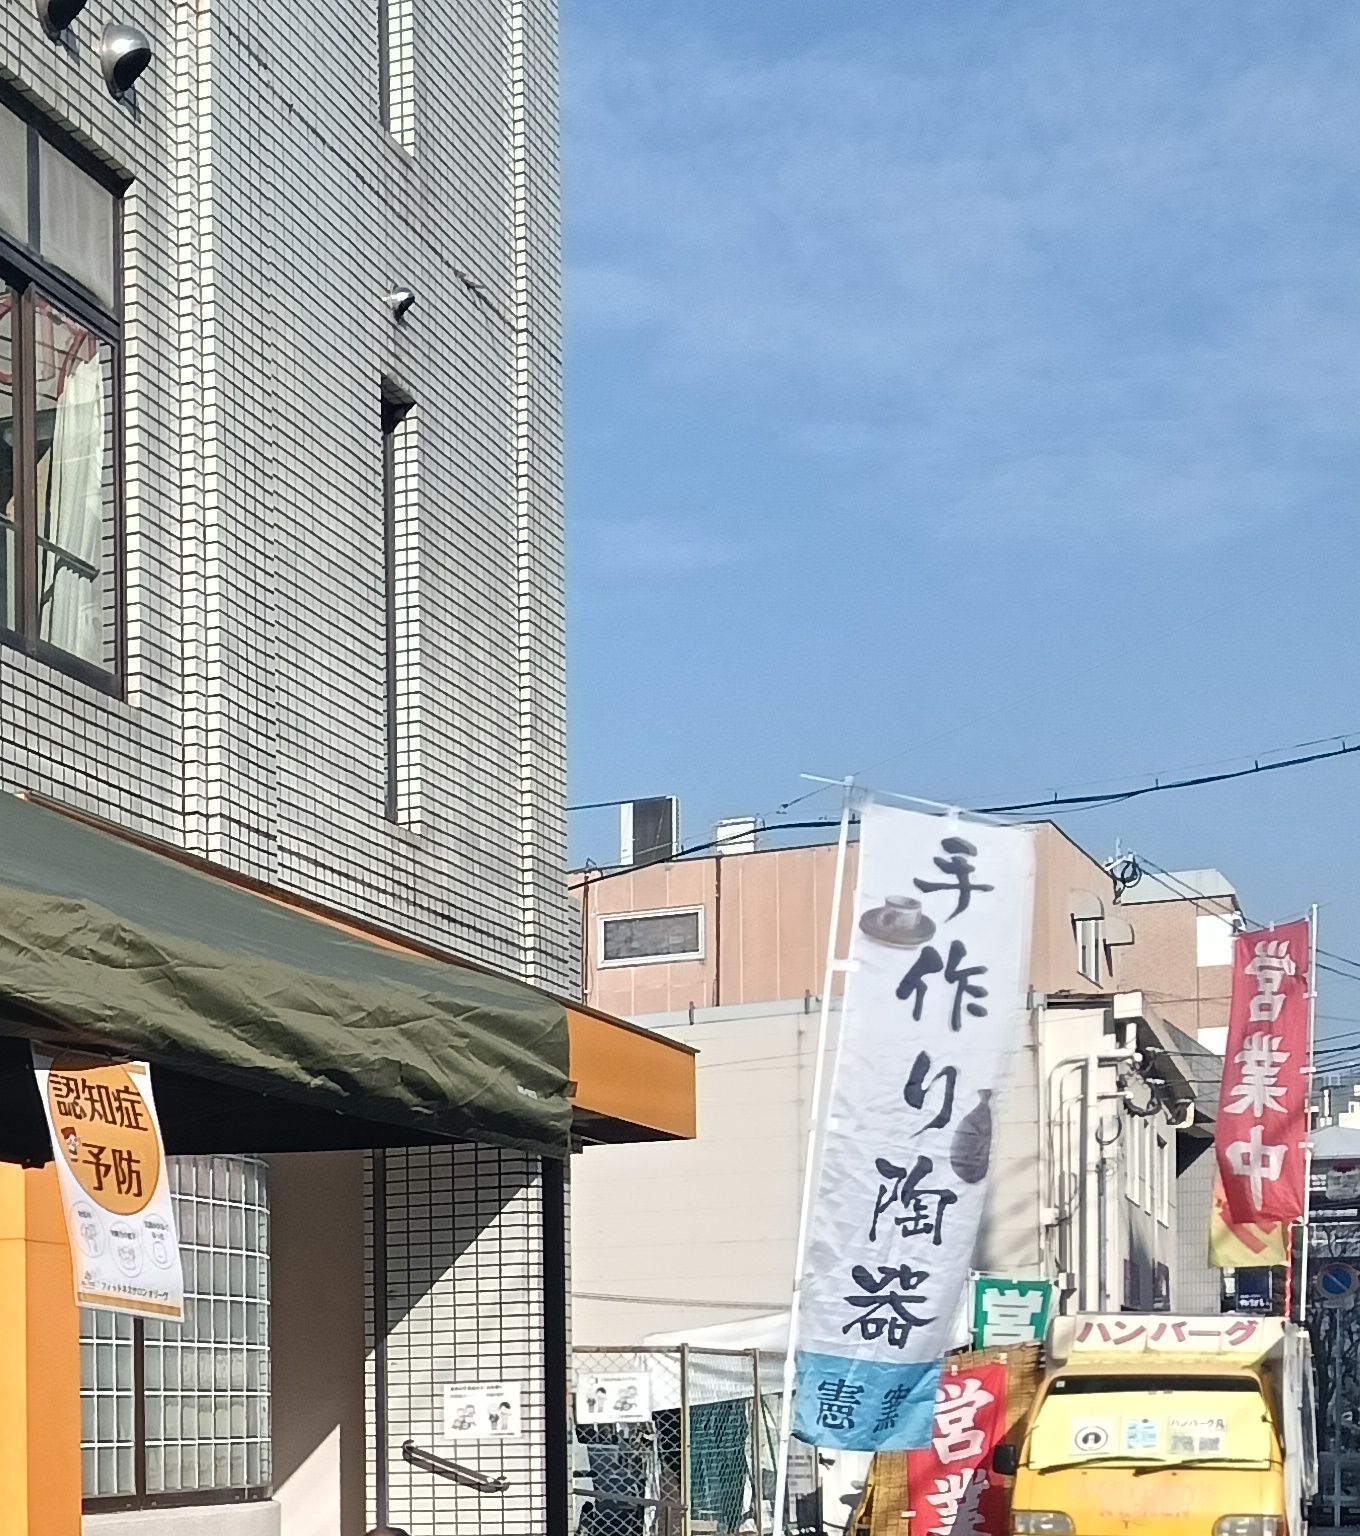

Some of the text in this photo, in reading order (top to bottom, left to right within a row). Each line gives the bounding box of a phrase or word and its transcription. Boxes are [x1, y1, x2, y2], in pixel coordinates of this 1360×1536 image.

[49, 1073, 149, 1133] 認知症
[841, 836, 995, 1350] 手作り陶器
[1223, 941, 1296, 1211] 営業中
[81, 1142, 143, 1198] 予防
[981, 1290, 1044, 1349] 営
[1076, 1319, 1259, 1346] ハンバーグ
